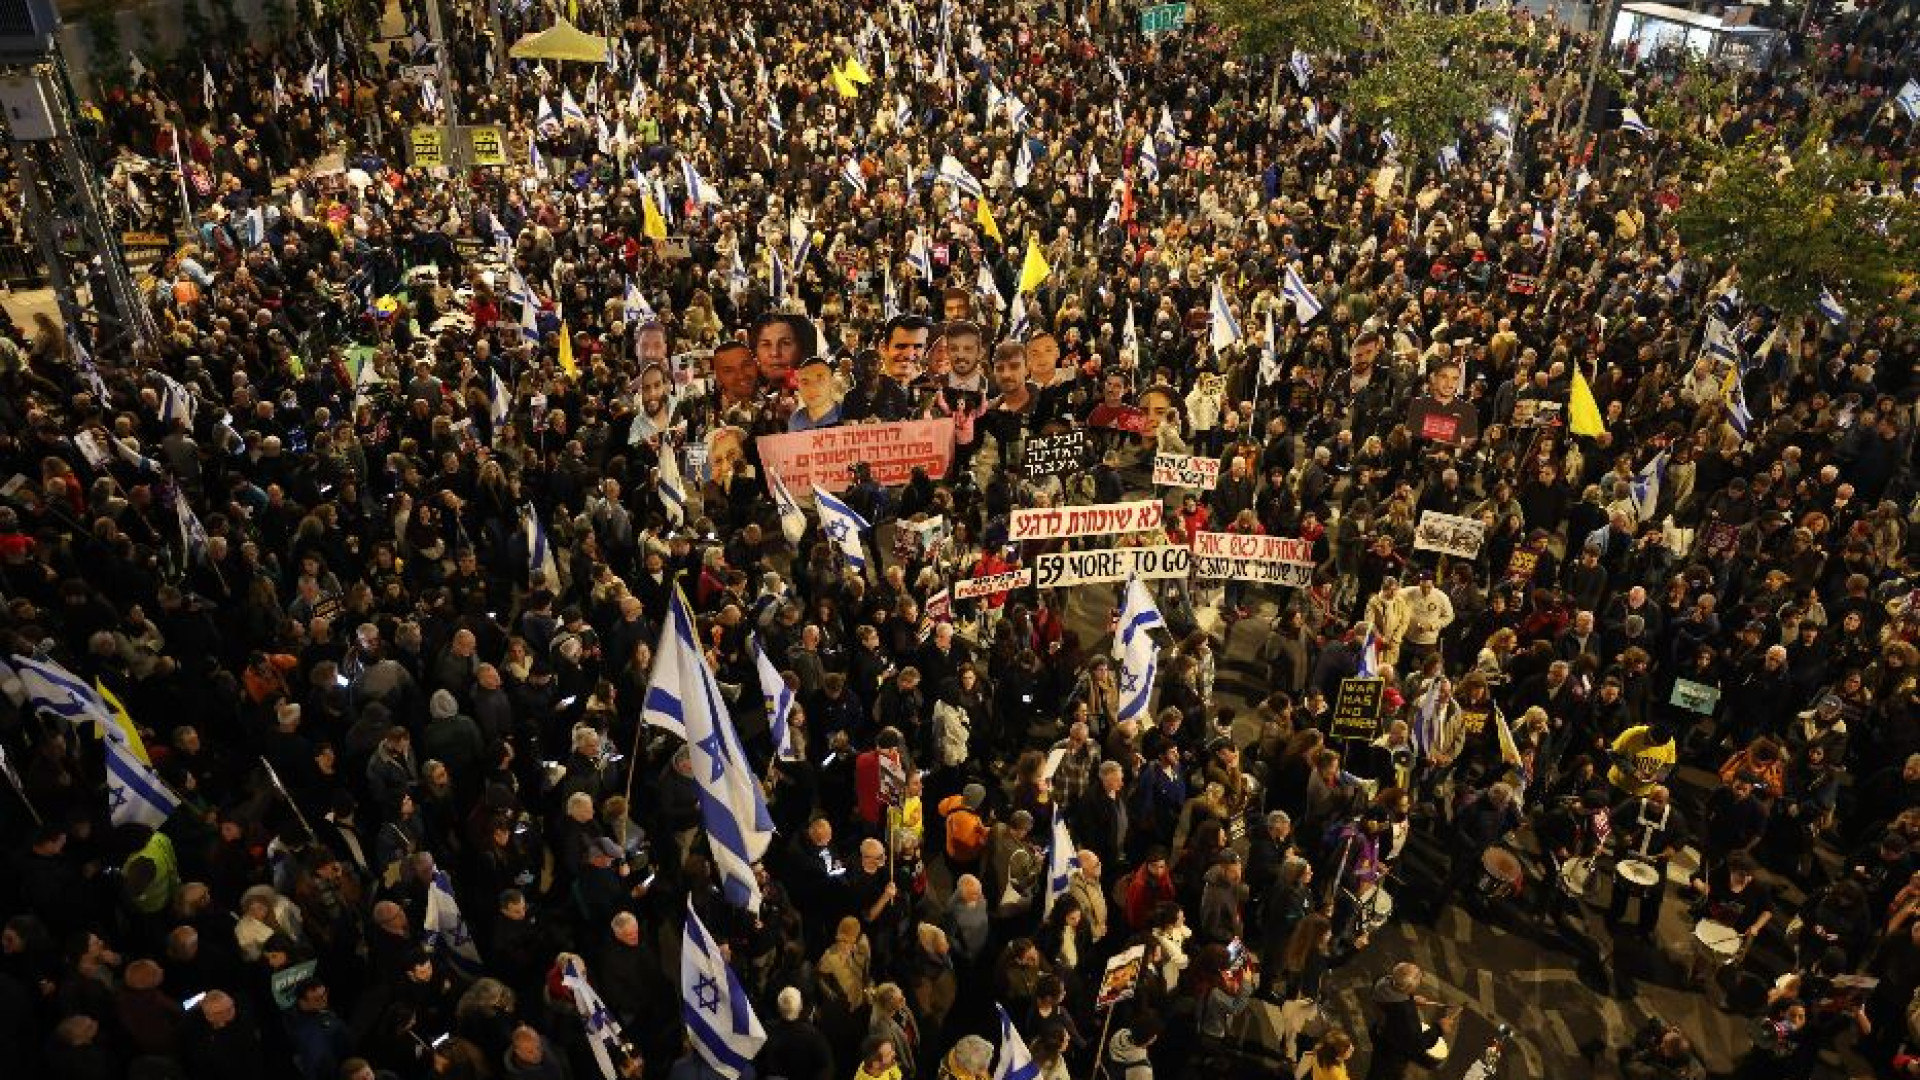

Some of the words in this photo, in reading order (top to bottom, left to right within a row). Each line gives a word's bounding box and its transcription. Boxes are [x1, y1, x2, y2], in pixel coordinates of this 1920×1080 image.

[1028, 446, 1083, 462] המדינה
[1138, 502, 1162, 529] לא
[1016, 512, 1062, 537] לרגע
[1038, 555, 1064, 584] 59
[1069, 552, 1125, 578] MORE
[1131, 550, 1157, 572] TO
[1162, 549, 1189, 573] GO
[1345, 682, 1376, 693] WAR
[1343, 694, 1372, 706] HAS
[1341, 707, 1361, 717] NO
